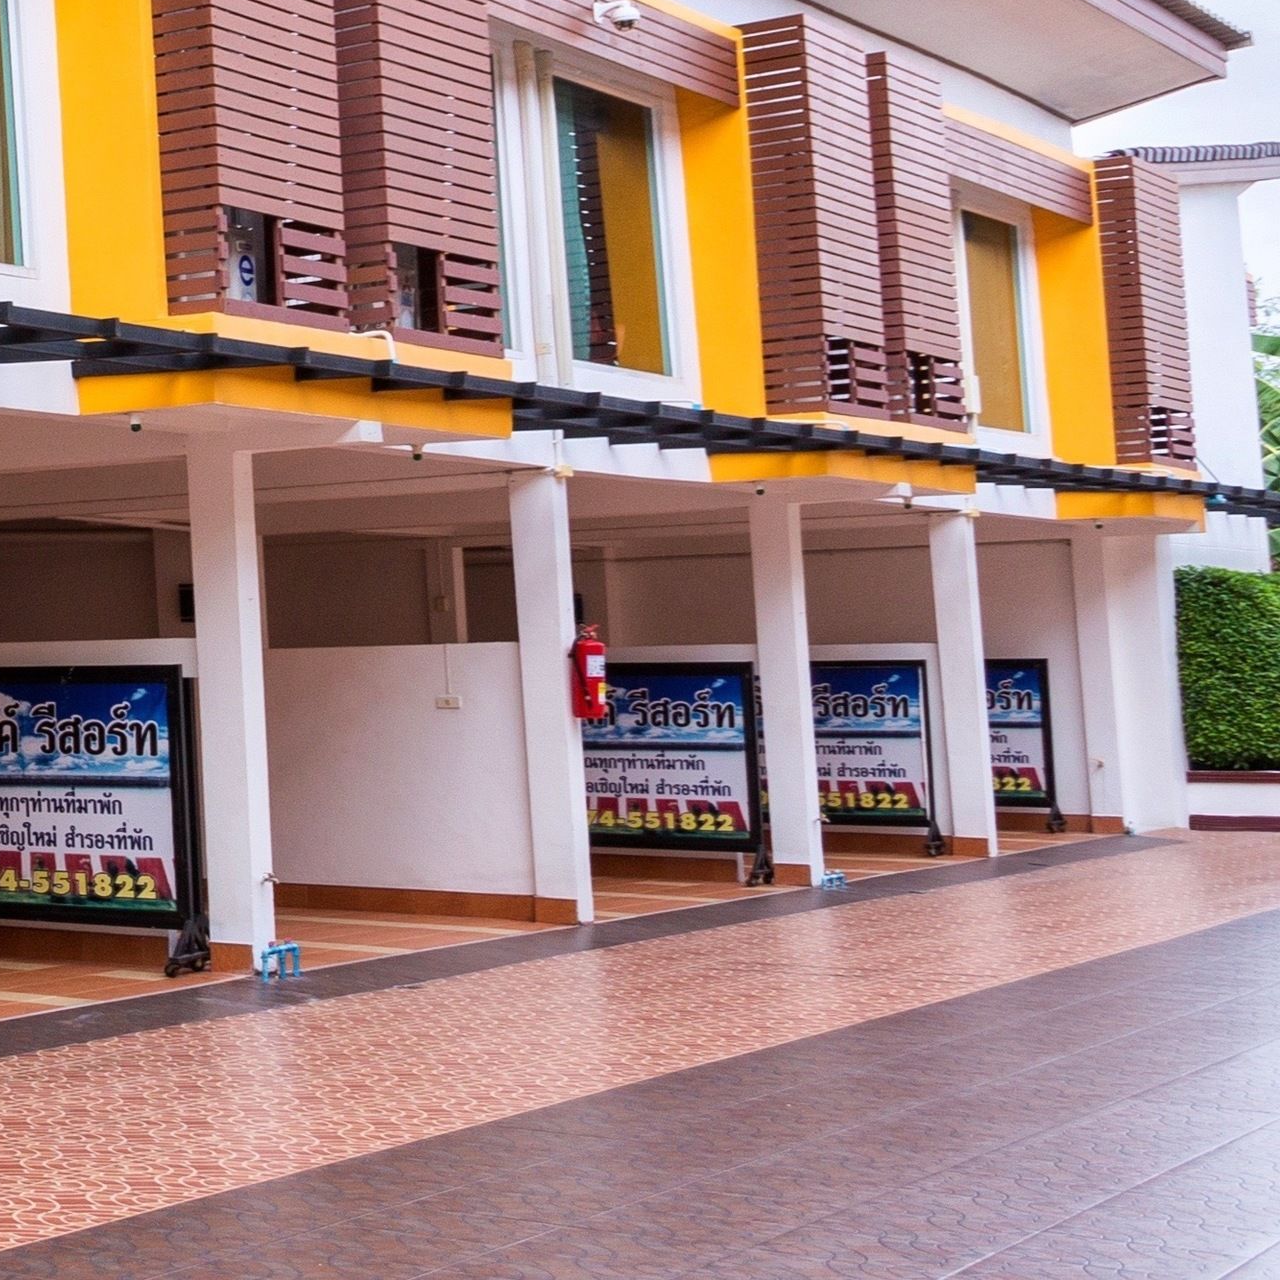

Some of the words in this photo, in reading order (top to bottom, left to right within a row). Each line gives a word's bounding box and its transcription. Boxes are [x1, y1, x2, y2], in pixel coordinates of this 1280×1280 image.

[625, 688, 736, 729] รีสอร์ท
[812, 683, 910, 719] รีสอร์ท
[31, 701, 159, 757] รีสอร์ท
[64, 822, 154, 851] สำรองที่พัก
